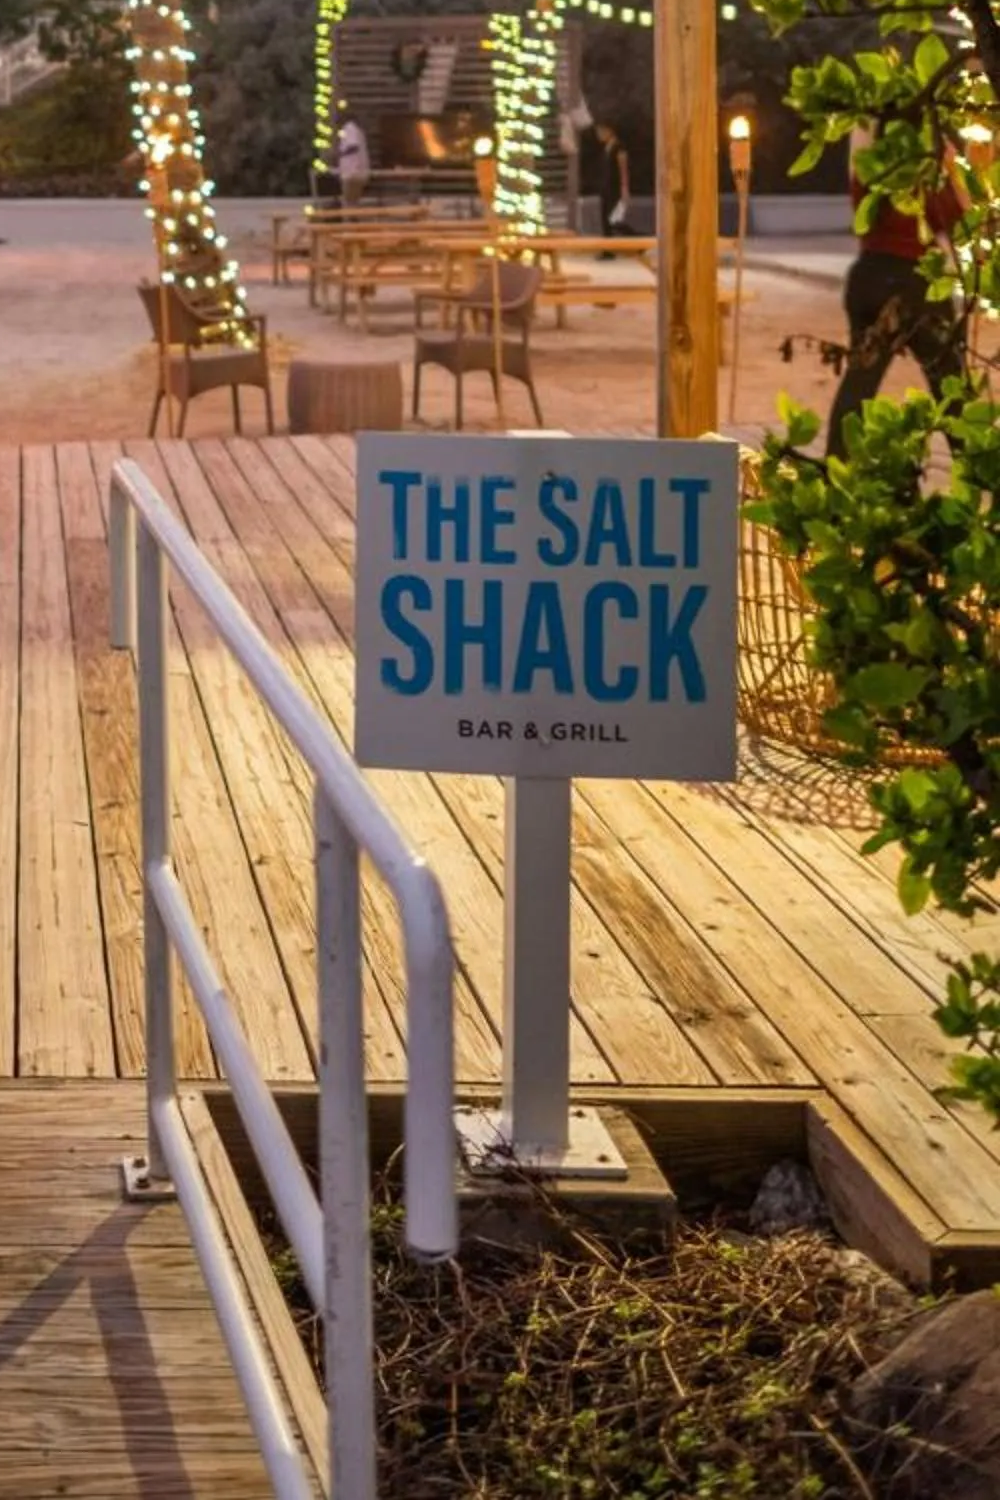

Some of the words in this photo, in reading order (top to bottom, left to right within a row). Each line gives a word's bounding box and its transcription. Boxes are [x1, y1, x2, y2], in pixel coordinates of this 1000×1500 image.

[378, 470, 517, 565] THE
[537, 474, 711, 569] SALT
[379, 574, 711, 703] SHACK
[458, 719, 513, 740] BAR
[523, 722, 539, 741] &
[549, 722, 629, 743] GRILL
